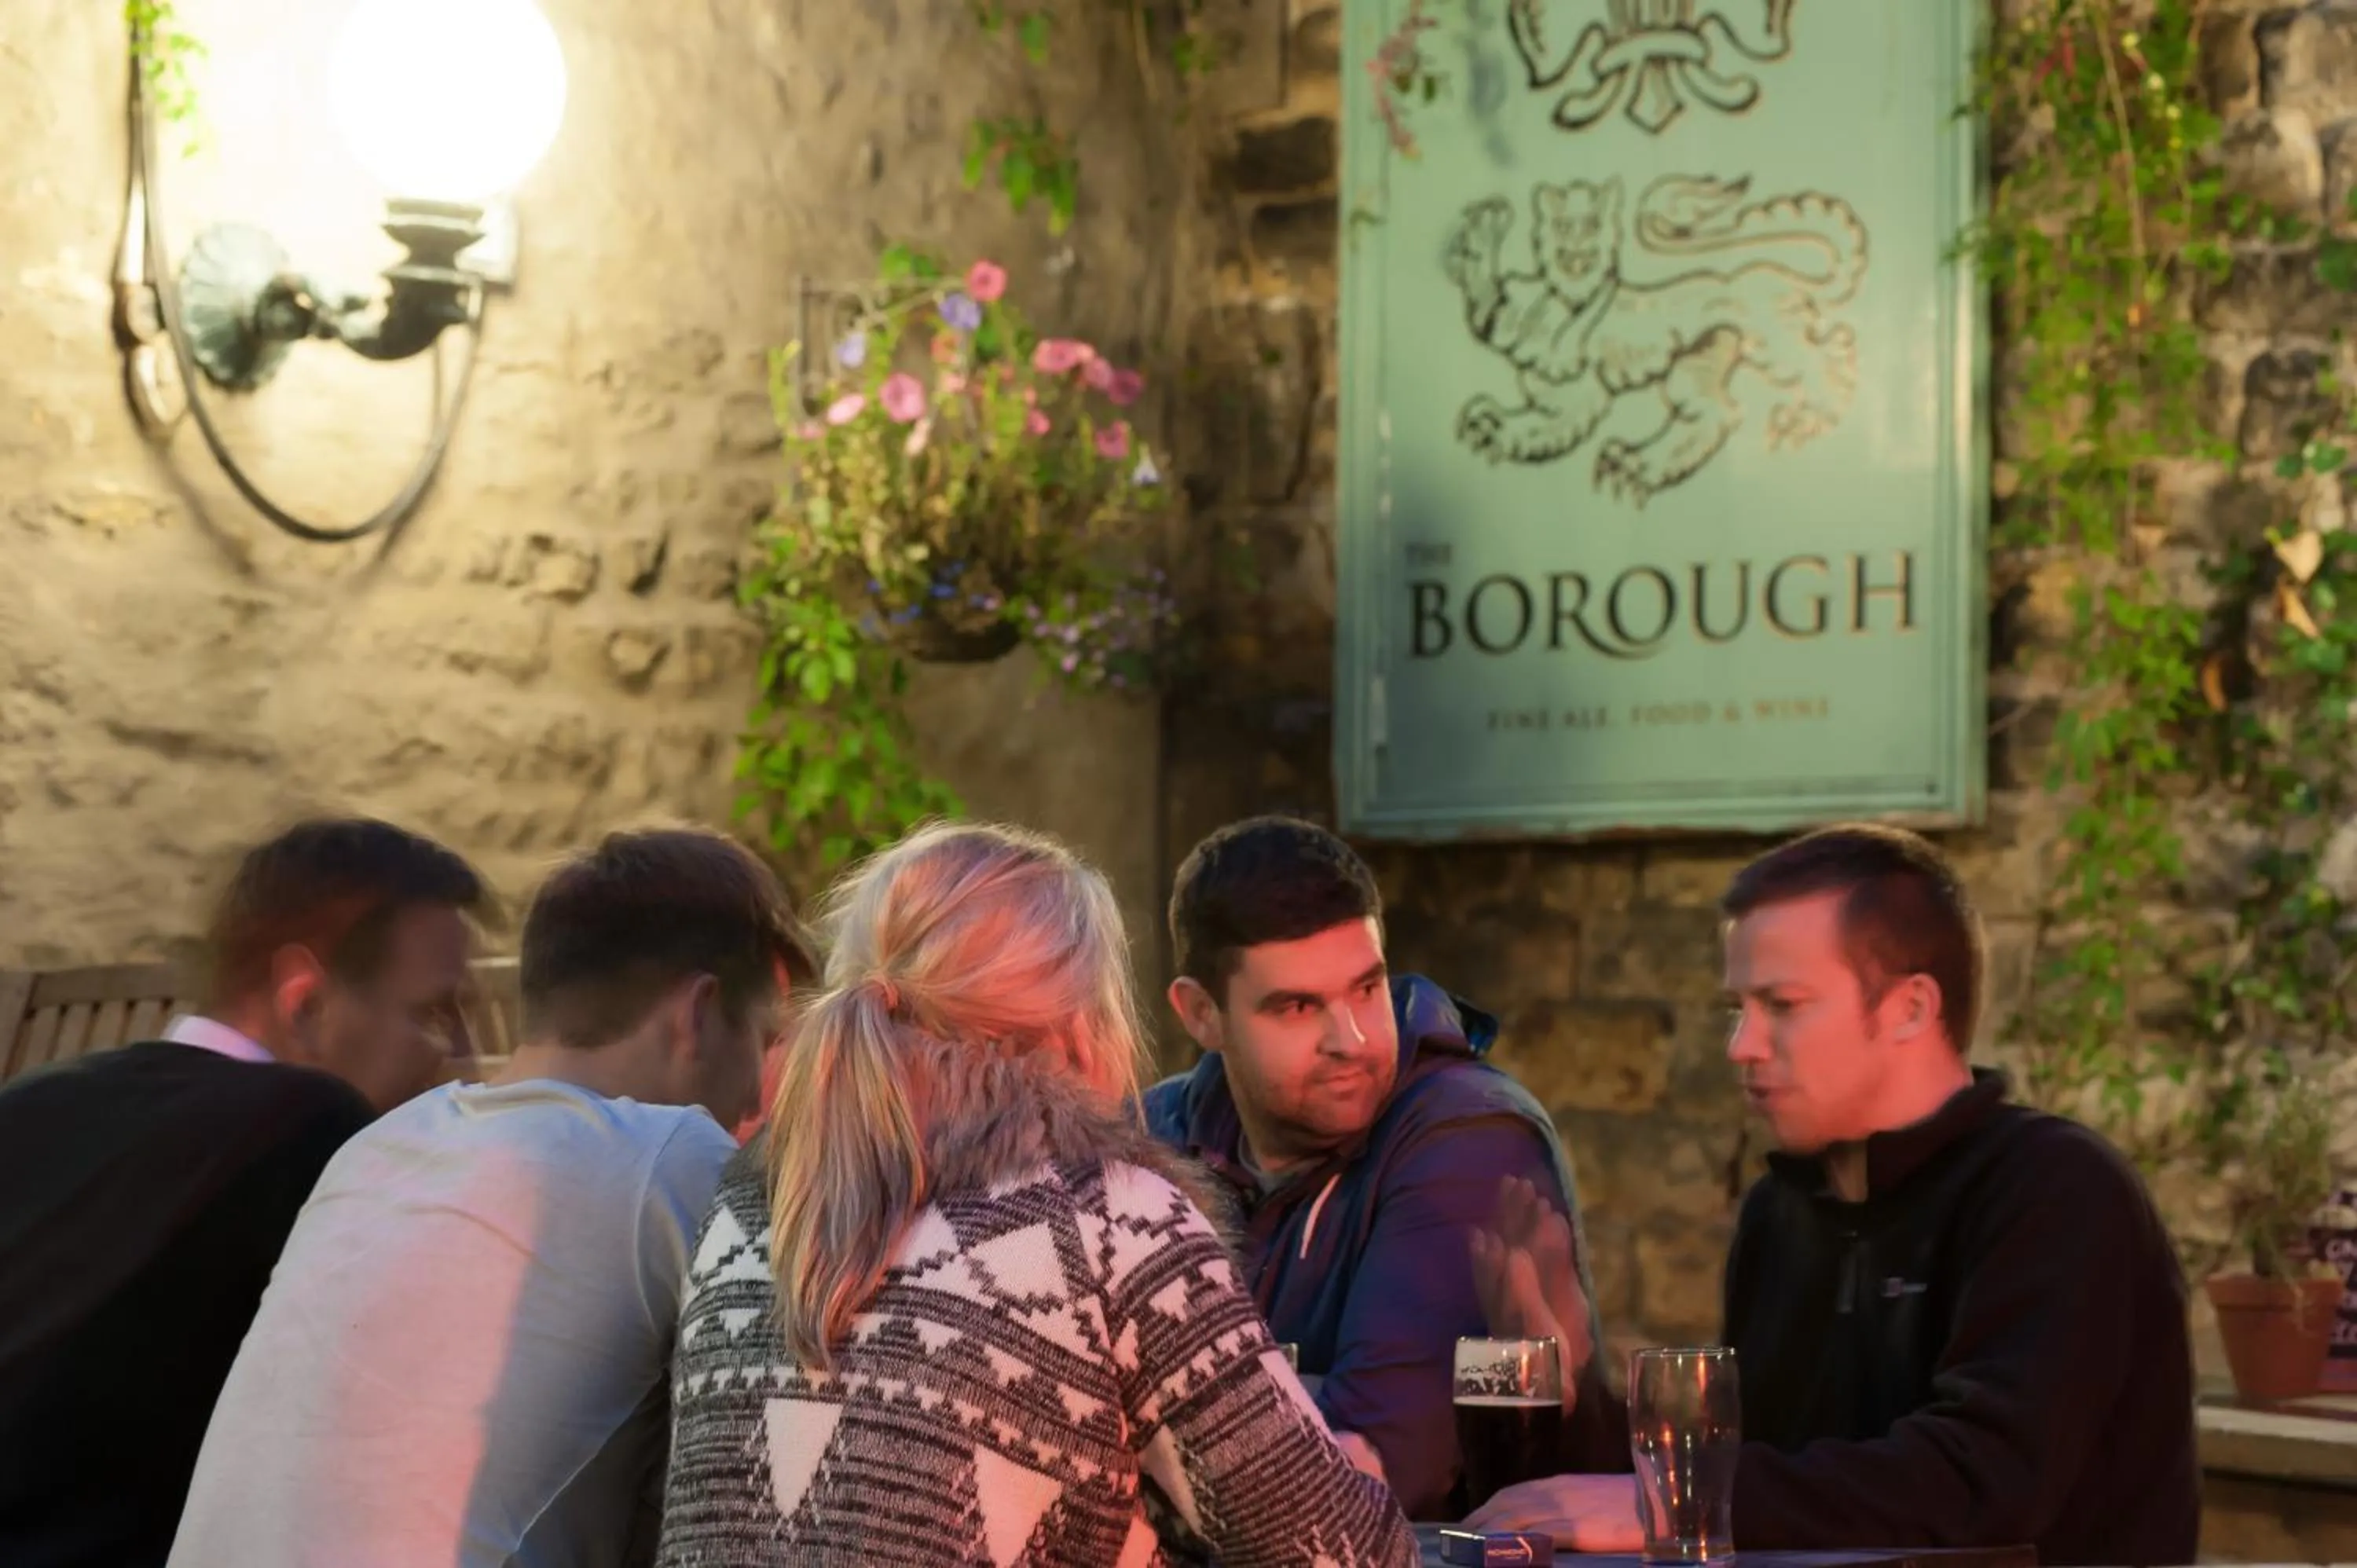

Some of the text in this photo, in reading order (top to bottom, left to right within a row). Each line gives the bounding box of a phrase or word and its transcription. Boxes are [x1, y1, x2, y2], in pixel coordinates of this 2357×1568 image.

[1406, 550, 1919, 660] BOROUGH
[1630, 702, 1710, 727] FOOD
[1753, 696, 1829, 722] WINE
